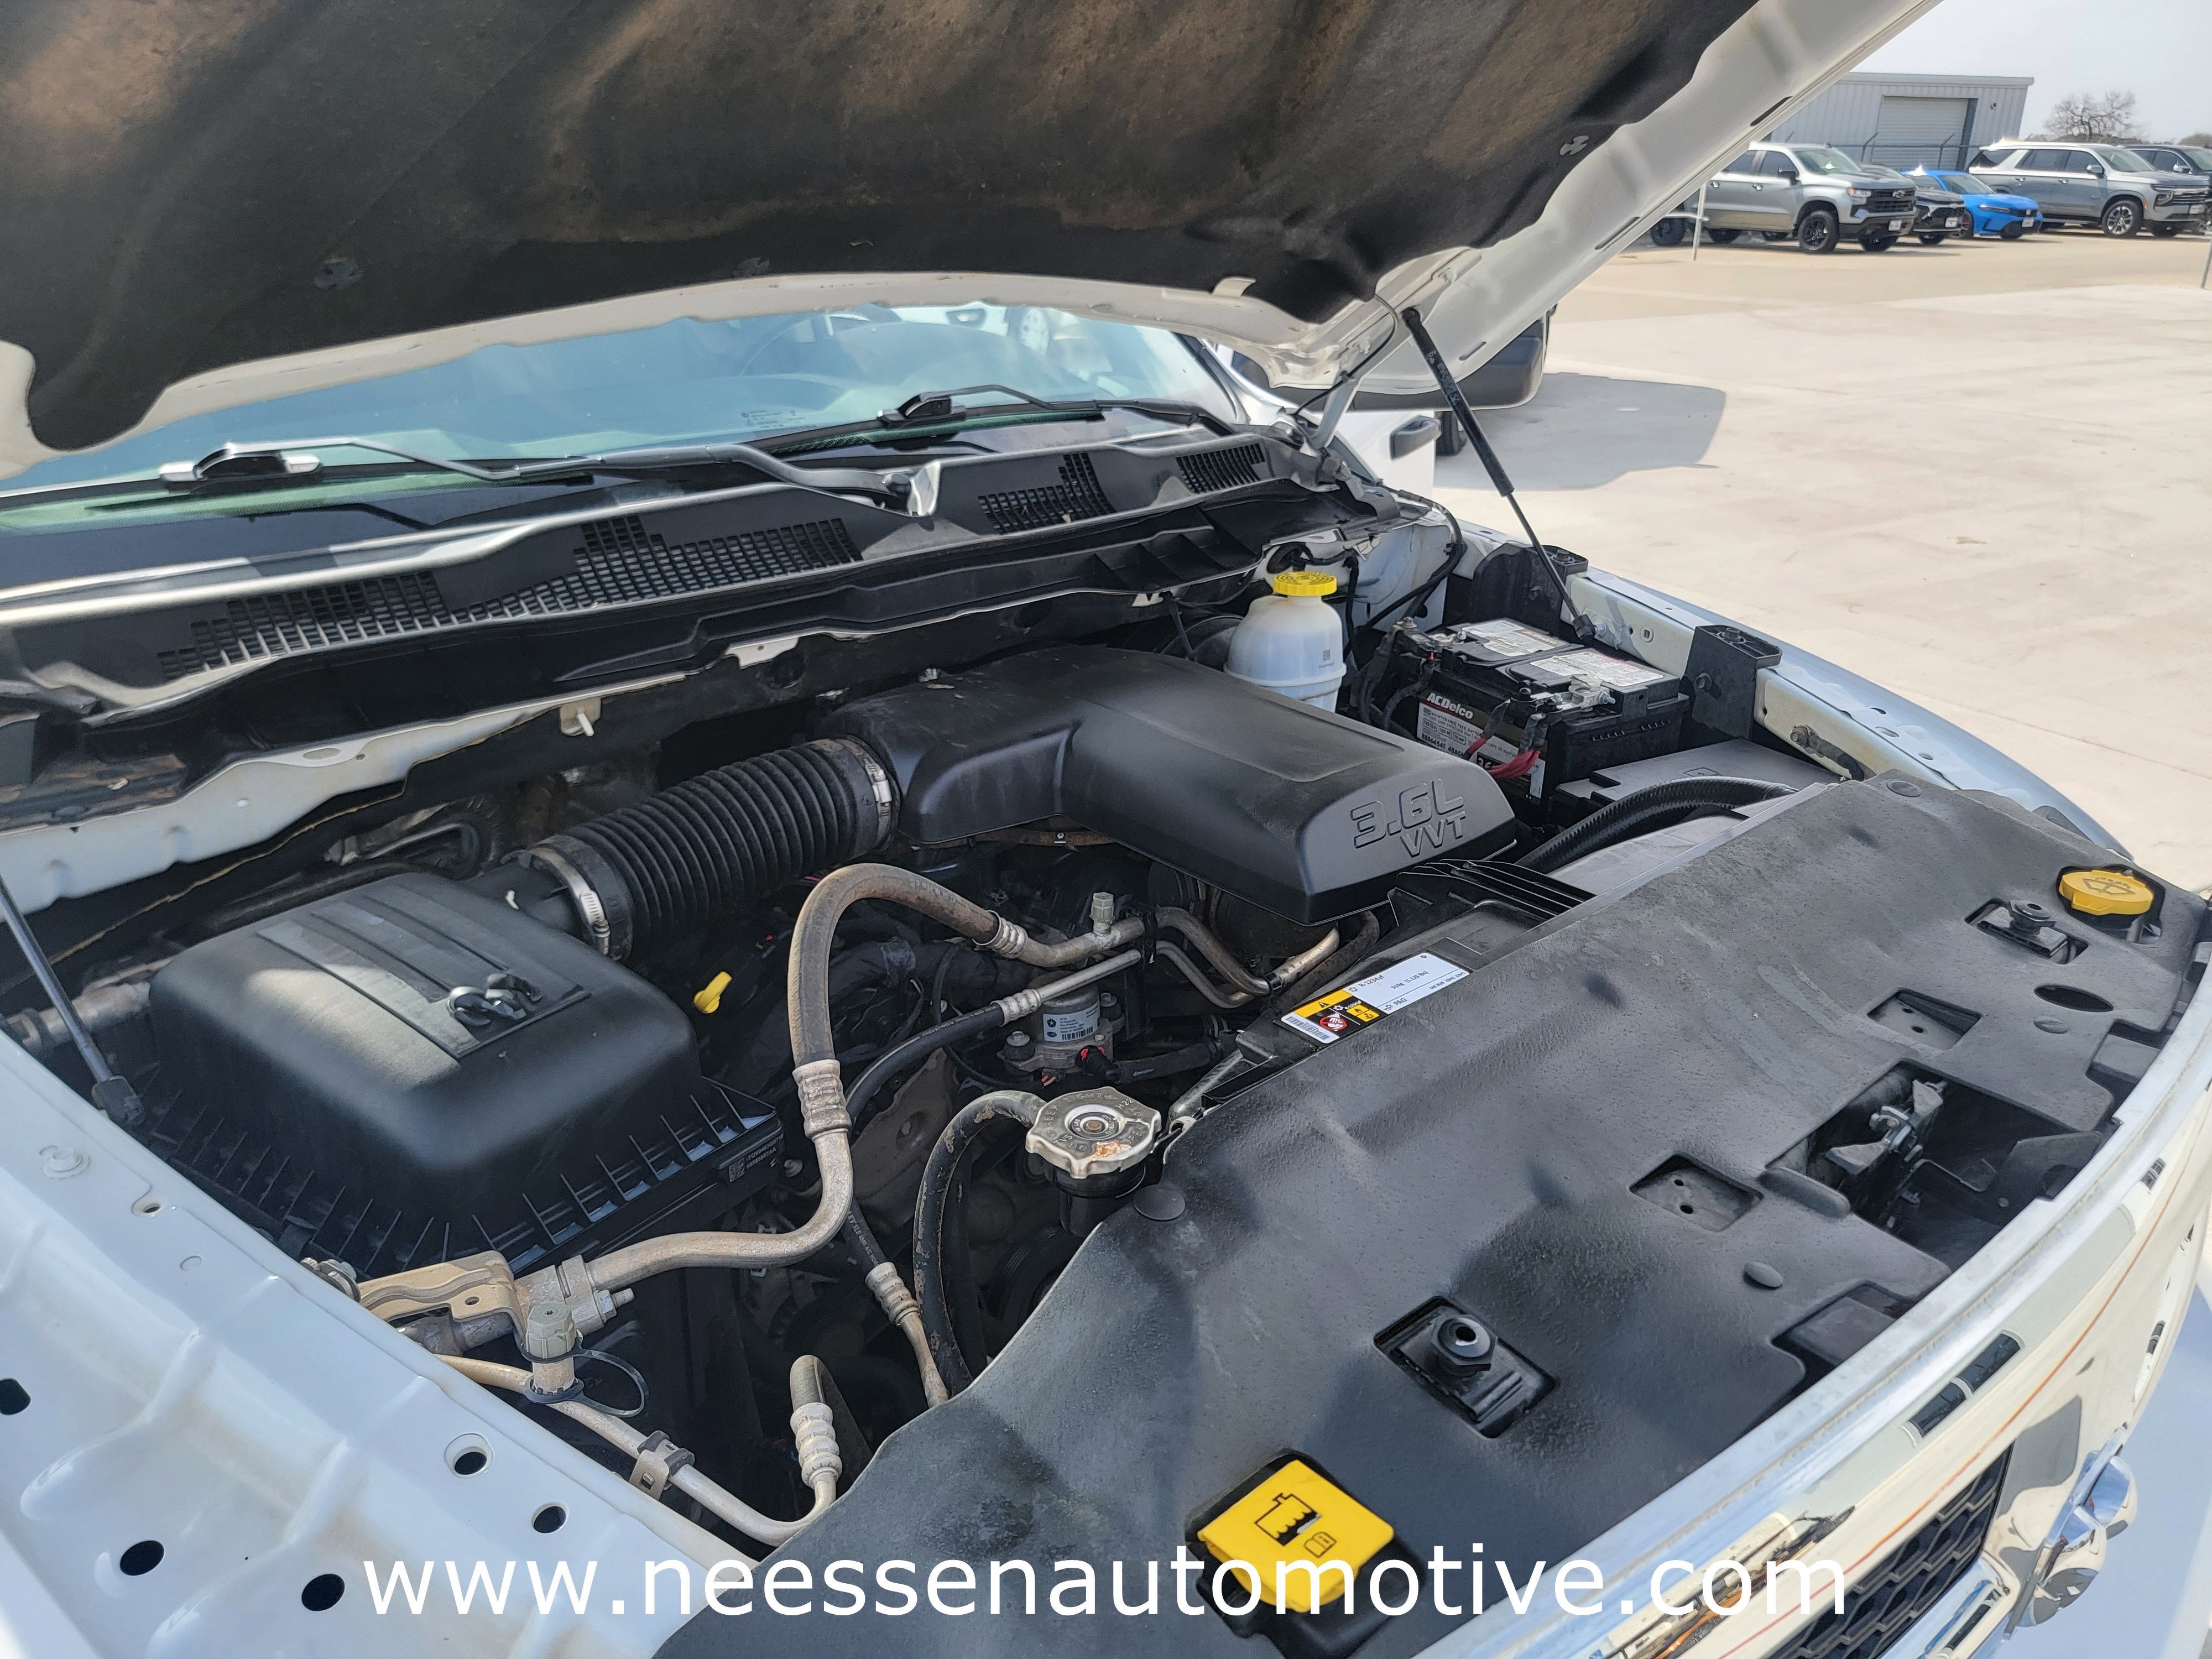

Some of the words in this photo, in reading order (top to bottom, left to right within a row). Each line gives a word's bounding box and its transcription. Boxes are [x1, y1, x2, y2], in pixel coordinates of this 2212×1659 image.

[1426, 693, 1473, 719] ACDelco
[1350, 778, 1464, 849] 3.6L
[1400, 811, 1466, 858] VVT
[1358, 974, 1385, 988] R-1234yf
[1393, 998, 1407, 1006] PAG
[1115, 1099, 1134, 1109] H22
[1053, 1134, 1073, 1146] TVS
